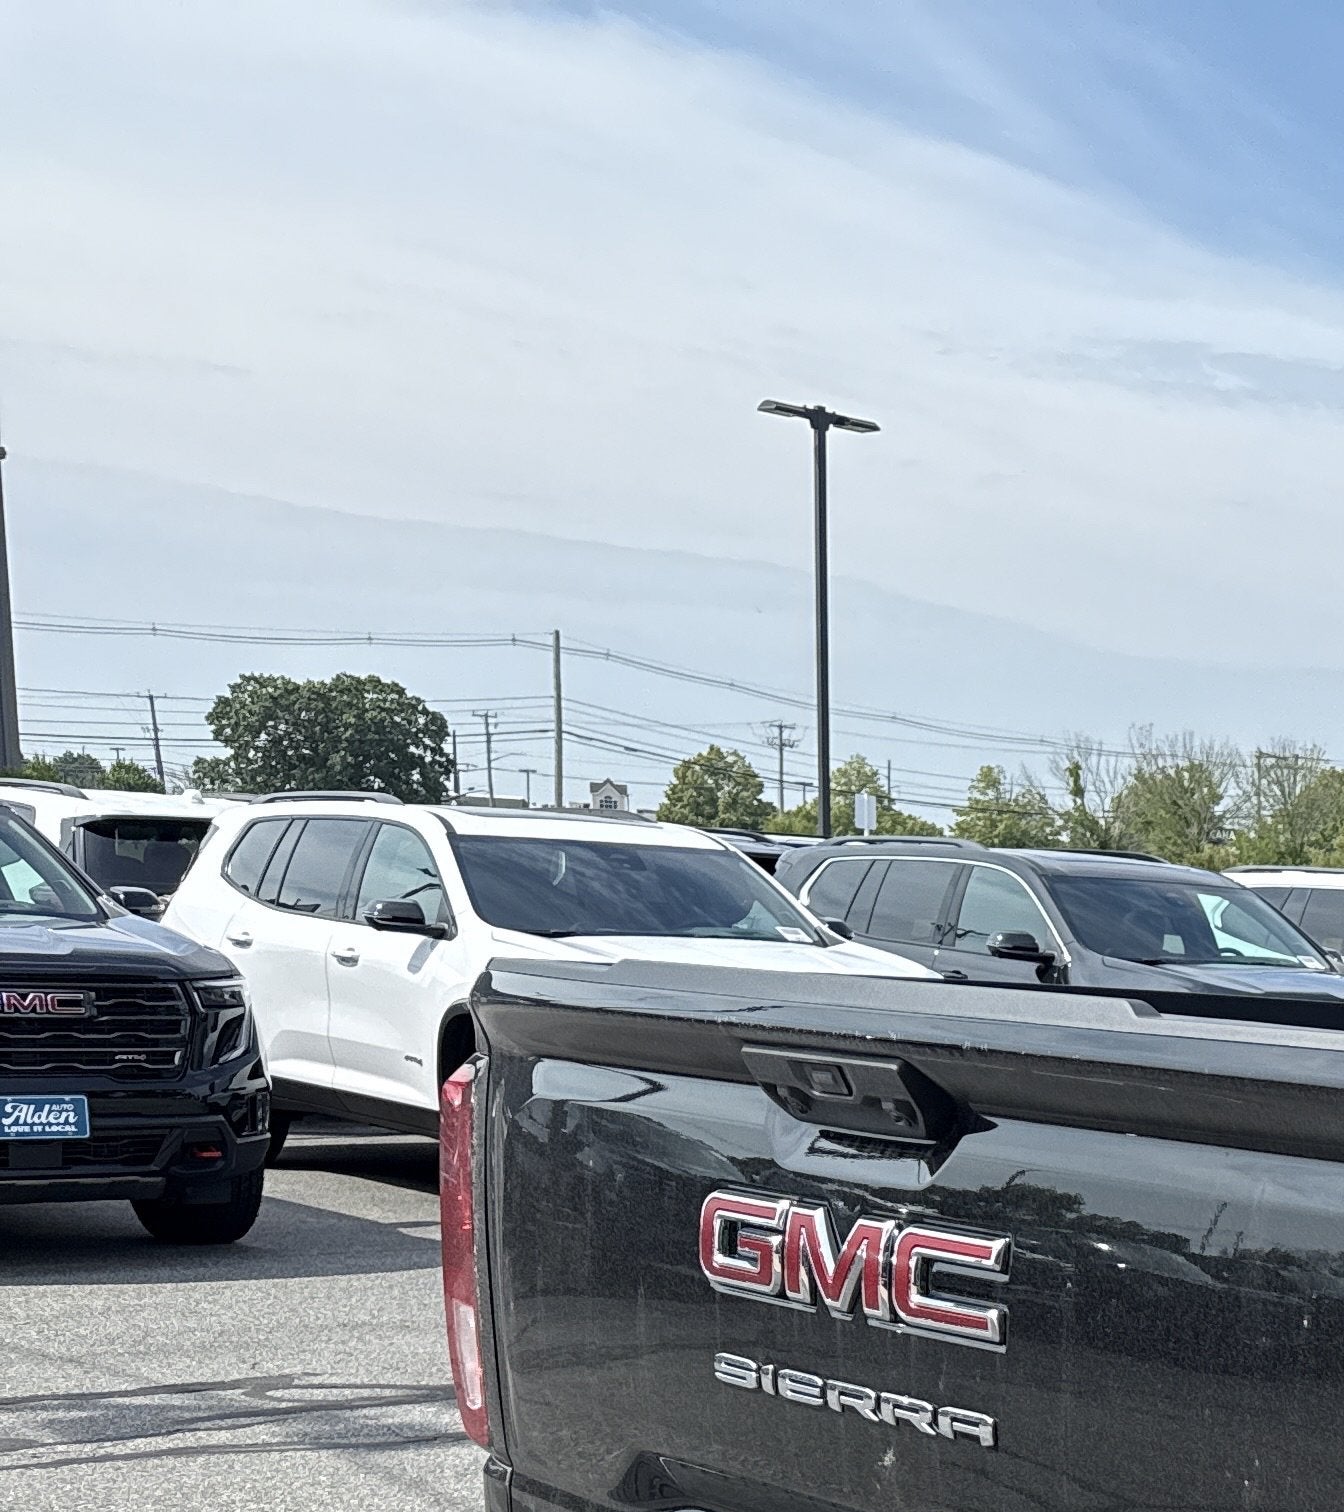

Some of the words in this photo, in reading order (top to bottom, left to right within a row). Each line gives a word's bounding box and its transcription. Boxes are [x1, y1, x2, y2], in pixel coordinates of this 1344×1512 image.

[0, 992, 86, 1013] MC
[1, 1102, 79, 1125] Alden
[51, 1103, 75, 1111] AUTO
[4, 1125, 31, 1133] LOVE
[700, 1190, 1012, 1354] GMC
[714, 1352, 999, 1447] SIERRA
